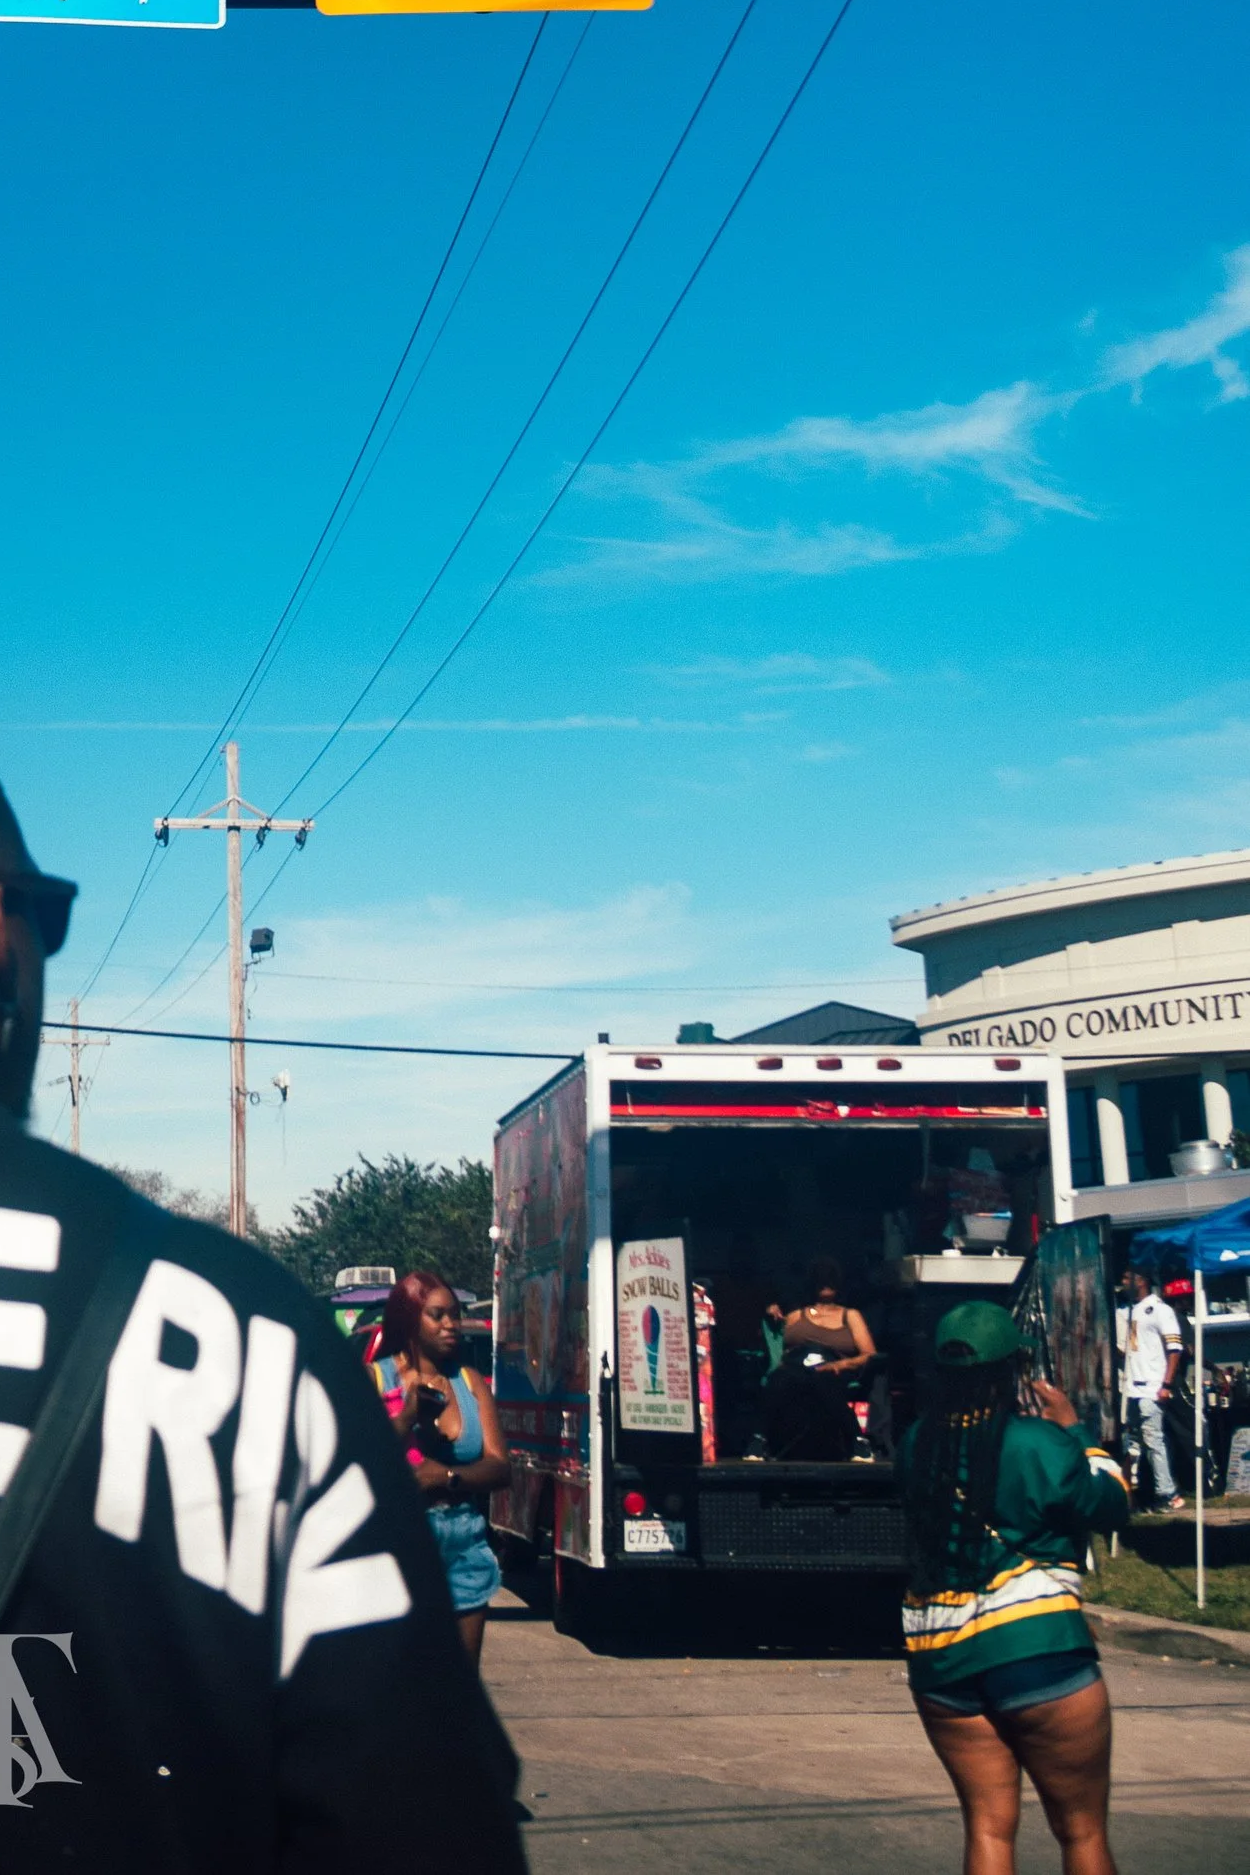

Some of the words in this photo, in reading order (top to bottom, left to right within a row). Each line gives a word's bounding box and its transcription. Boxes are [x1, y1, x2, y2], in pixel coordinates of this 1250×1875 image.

[947, 1016, 1056, 1047] DELGADO
[1065, 990, 1250, 1039] COMMUNIT
[621, 1276, 648, 1303] SNOW
[648, 1275, 680, 1302] BALLS
